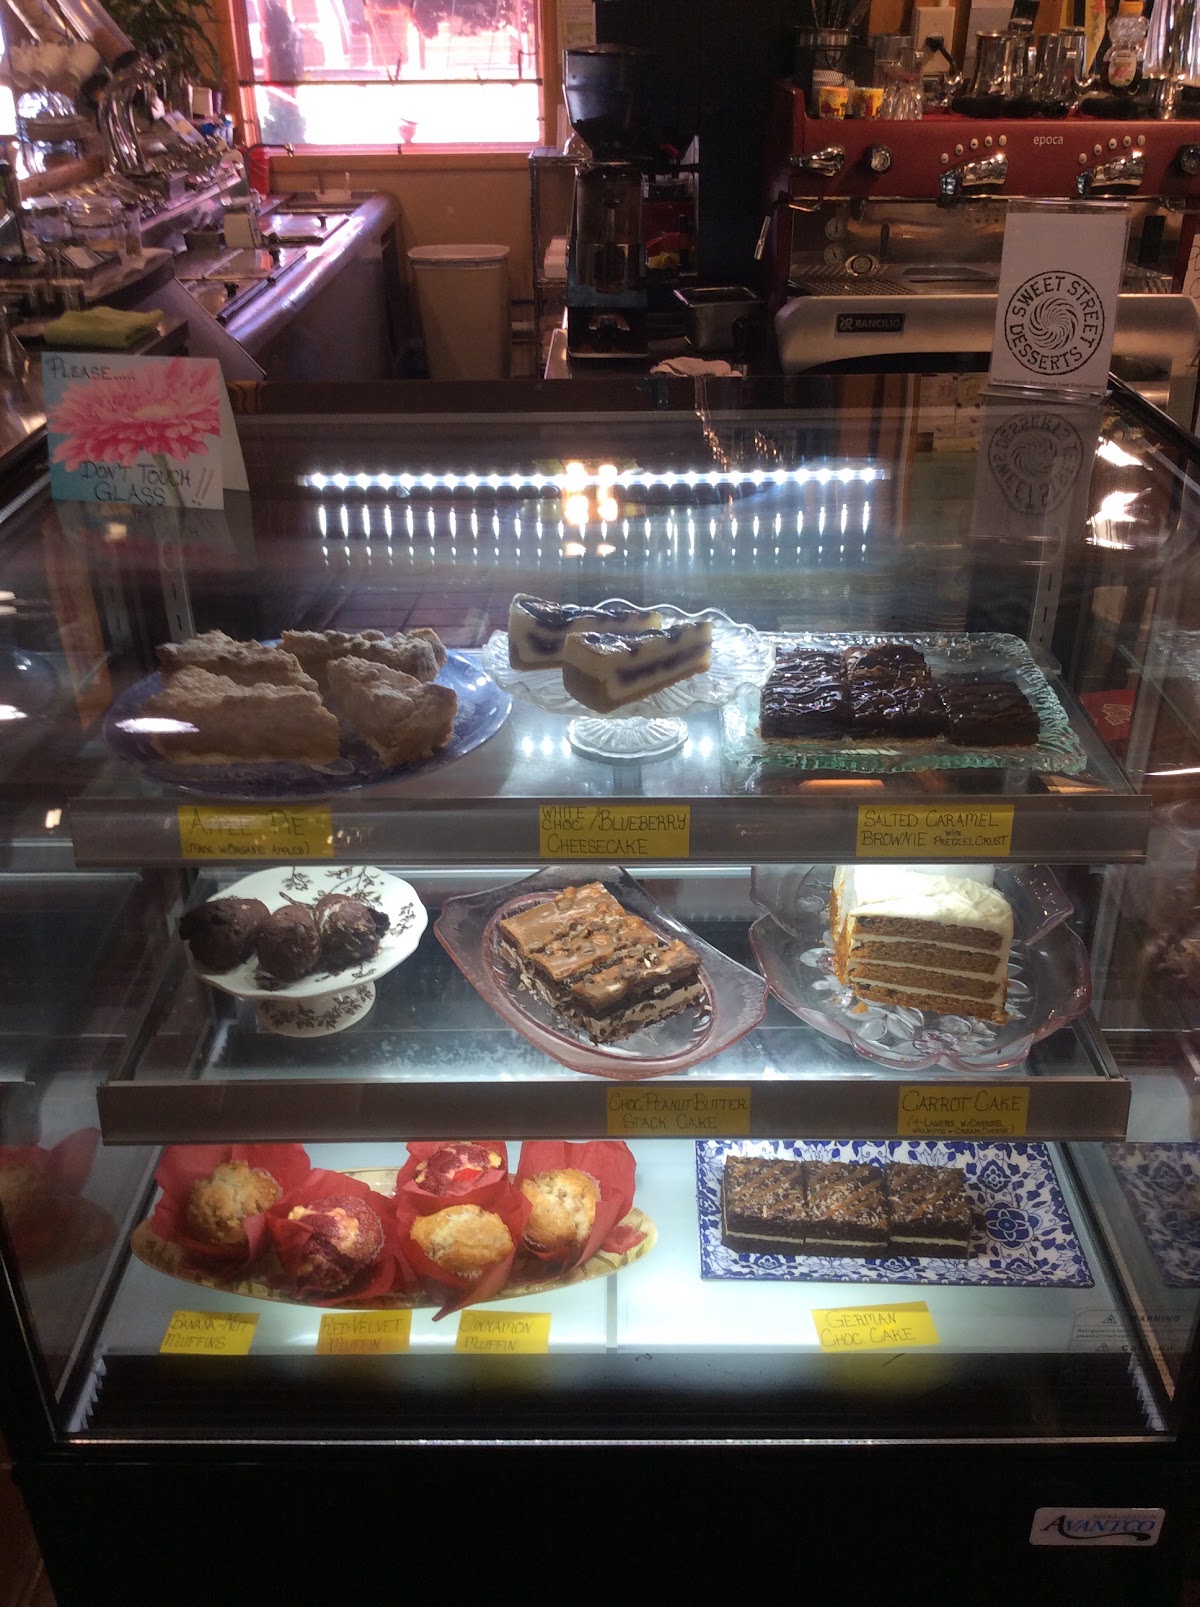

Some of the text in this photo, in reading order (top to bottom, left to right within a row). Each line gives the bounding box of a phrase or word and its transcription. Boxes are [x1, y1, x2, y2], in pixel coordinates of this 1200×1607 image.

[1033, 135, 1064, 147] epoca
[1011, 276, 1100, 349] SWEET STREET
[855, 319, 901, 329] RANCILIO
[1009, 324, 1083, 371] DESSERTS
[80, 460, 129, 482] DON'T
[136, 462, 192, 488] TOUCH
[93, 481, 166, 506] GLASS
[189, 808, 306, 836] APPLE PIE
[542, 806, 586, 820] WHITE
[863, 810, 1000, 828] SALTED CARAMEL
[546, 832, 649, 855] CHEESECAKE
[860, 830, 1009, 847] BROWNIE PRETZEL CRUST
[642, 1092, 692, 1112] PEANUT
[692, 1092, 748, 1111] BUTTER
[901, 1089, 1023, 1112] CARROT CAKE
[622, 1113, 720, 1130] STACK CAKE
[321, 1315, 406, 1336] RED VELVET
[459, 1312, 534, 1334] CINNAMON
[825, 1309, 897, 1329] GERMAN
[164, 1333, 227, 1350] MUFFINS
[464, 1336, 521, 1351] MUFFIN
[869, 1327, 917, 1344] CAKE
[1040, 1514, 1156, 1541] AVANTCO
